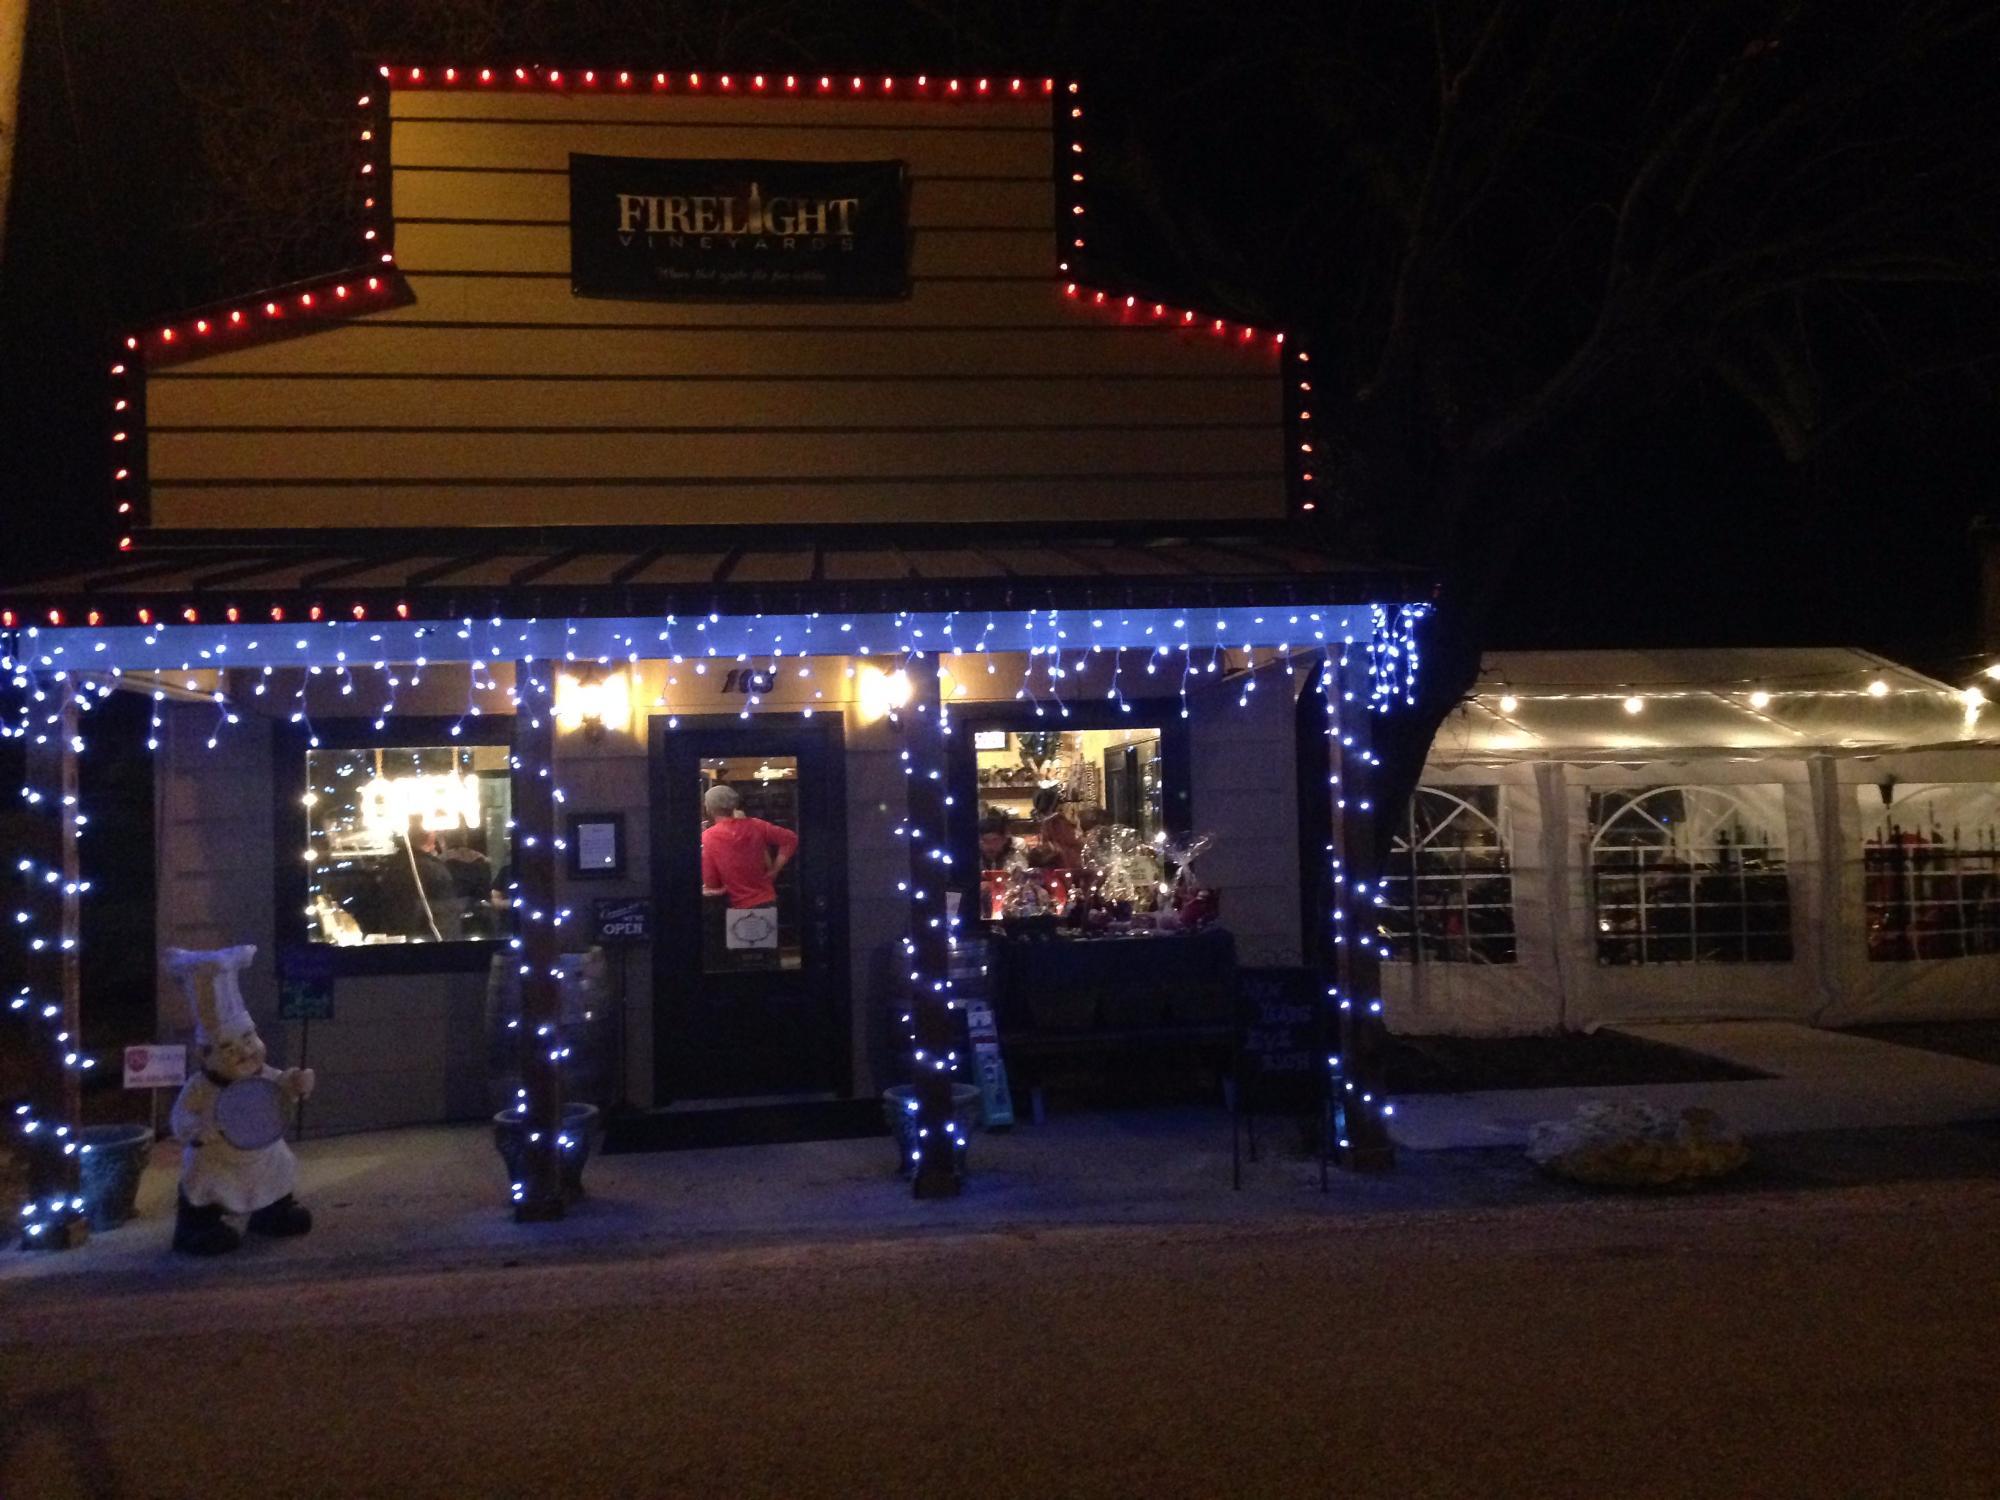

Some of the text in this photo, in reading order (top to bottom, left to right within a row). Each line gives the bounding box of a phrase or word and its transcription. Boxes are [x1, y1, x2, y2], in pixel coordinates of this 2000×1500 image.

[616, 182, 859, 236] FIRELIGHT
[619, 236, 854, 250] VINEYARDS
[602, 923, 643, 935] OPEN
